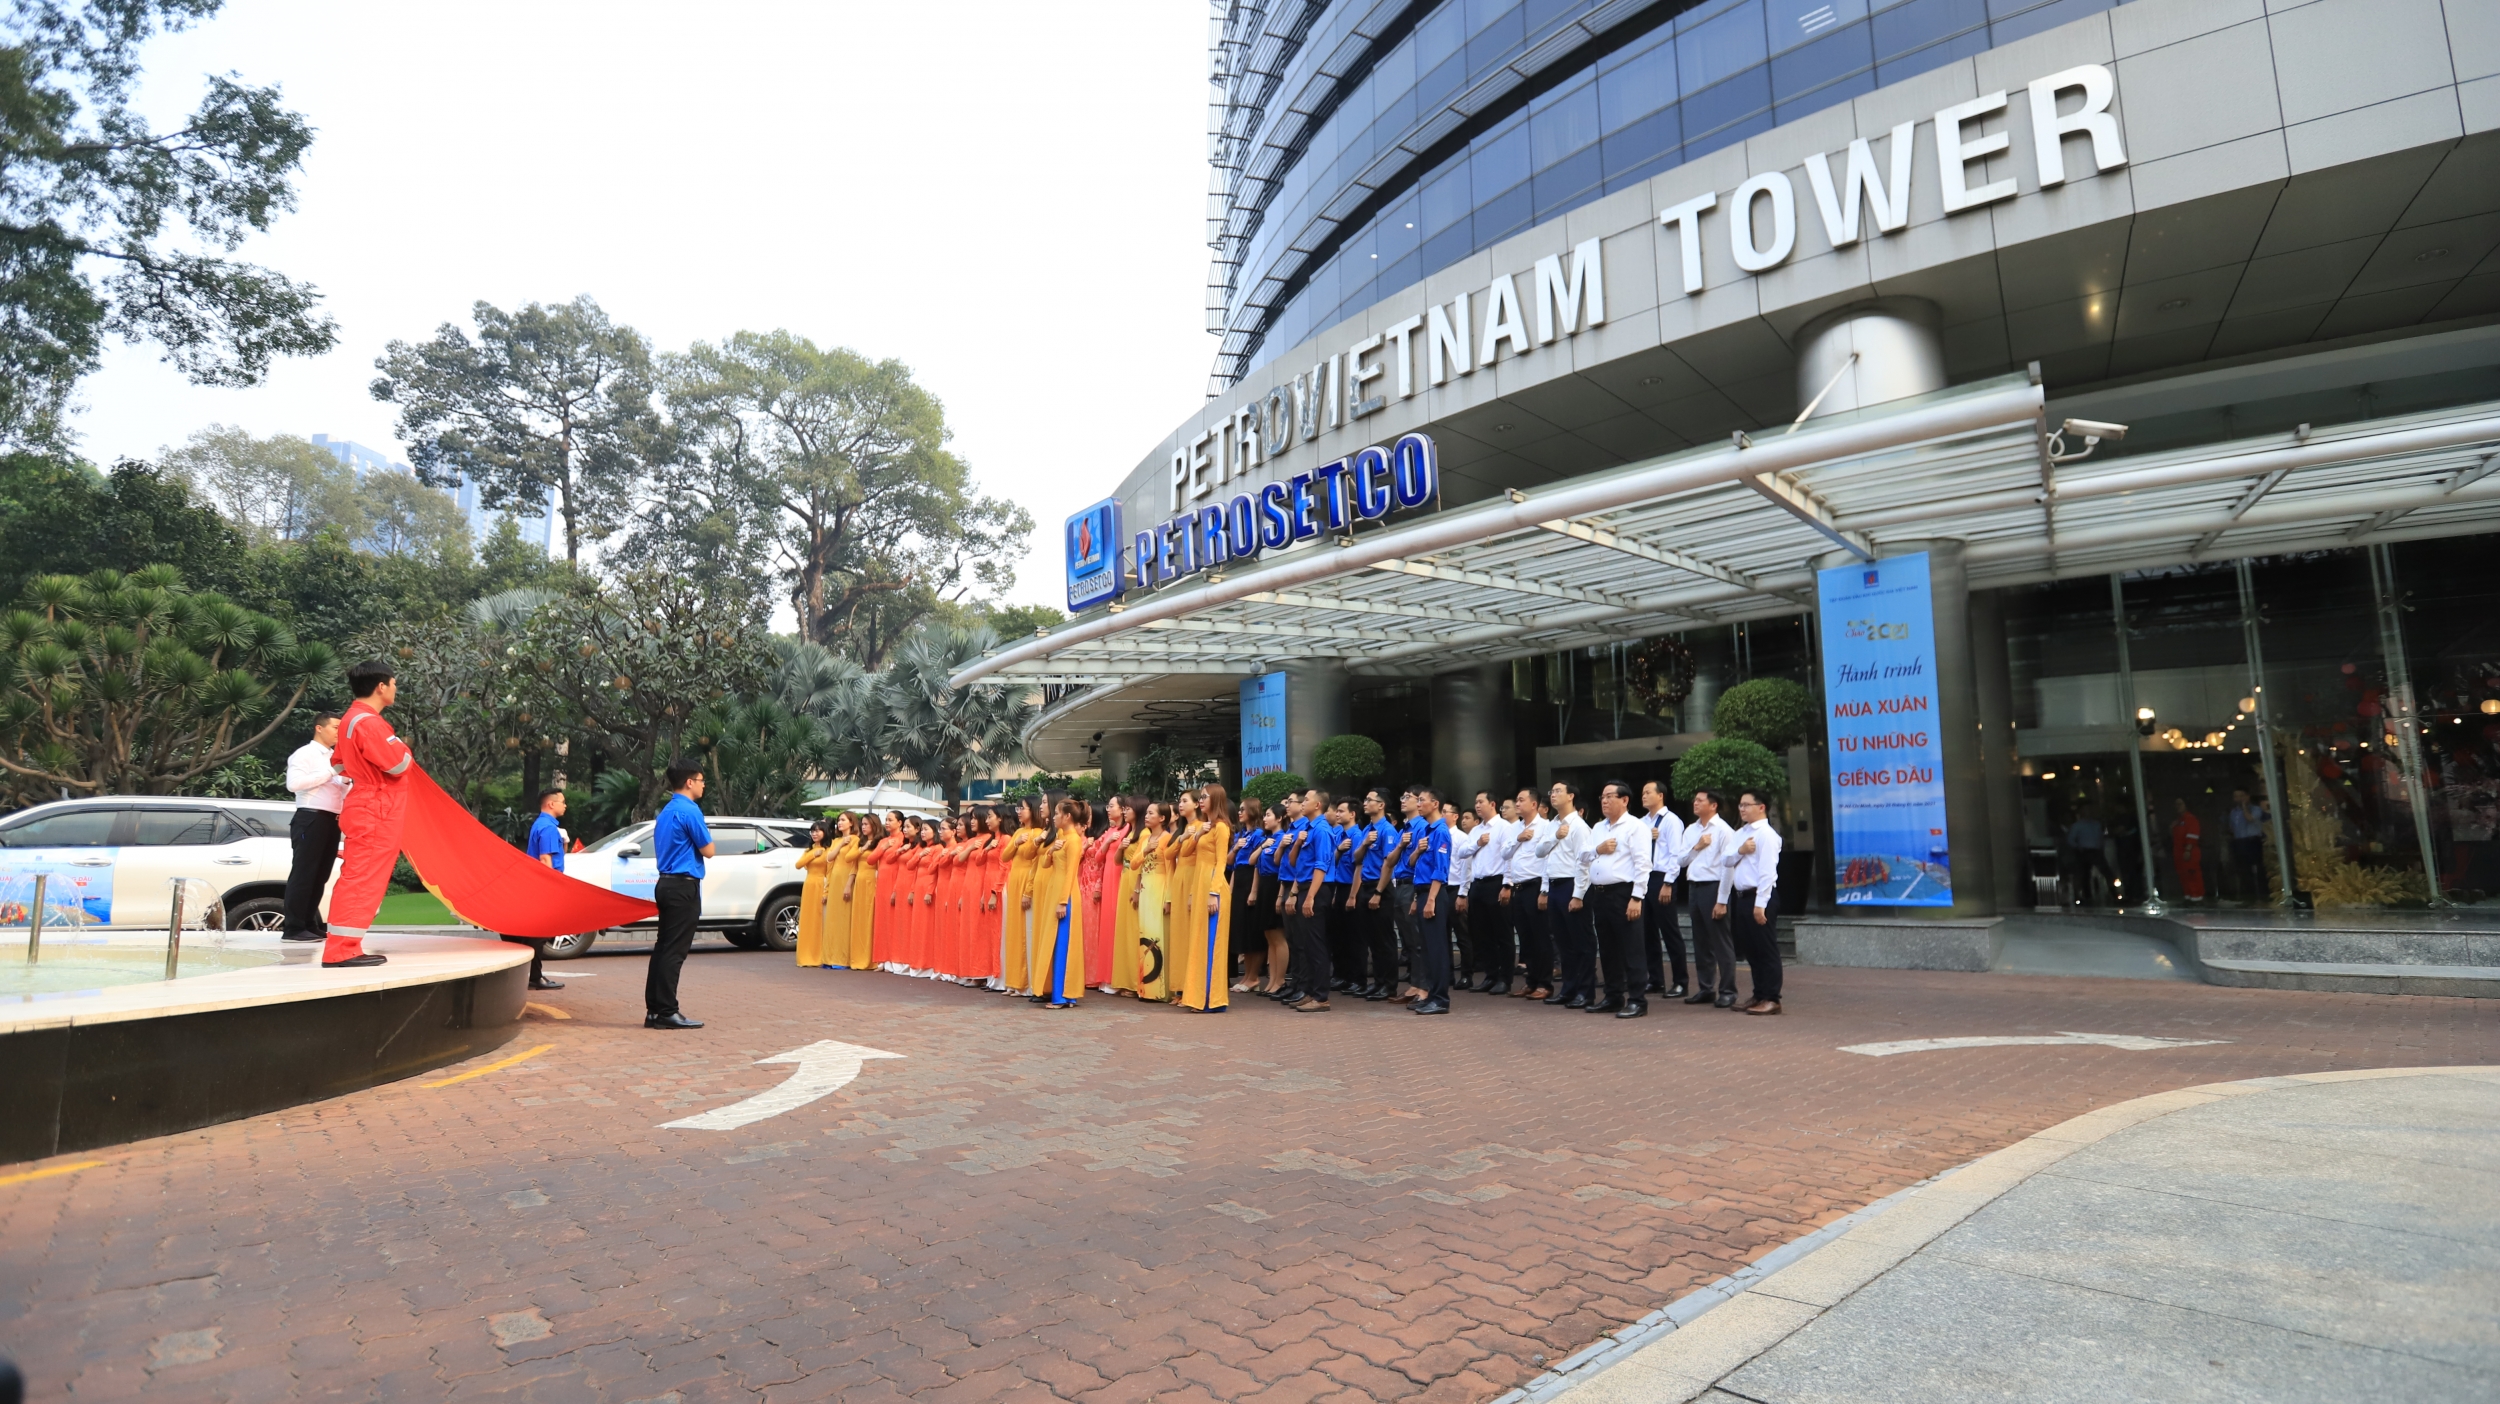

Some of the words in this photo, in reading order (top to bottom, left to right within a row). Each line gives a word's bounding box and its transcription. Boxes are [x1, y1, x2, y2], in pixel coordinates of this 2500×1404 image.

[1169, 236, 1607, 513] PETROVIETNAM
[1660, 63, 2130, 296] TOWER
[1135, 431, 1438, 589] PETROSETCO
[1069, 570, 1113, 600] PETROSETCO
[1835, 660, 1878, 688] Hành
[1883, 655, 1923, 679] trình
[1834, 699, 1873, 718] MÙA
[1878, 694, 1928, 714] XUÂN
[1837, 733, 1859, 752] TỪ
[1863, 731, 1929, 750] NHỮNG
[1837, 766, 1891, 787] GIẾNG
[1896, 763, 1933, 784] DẦU
